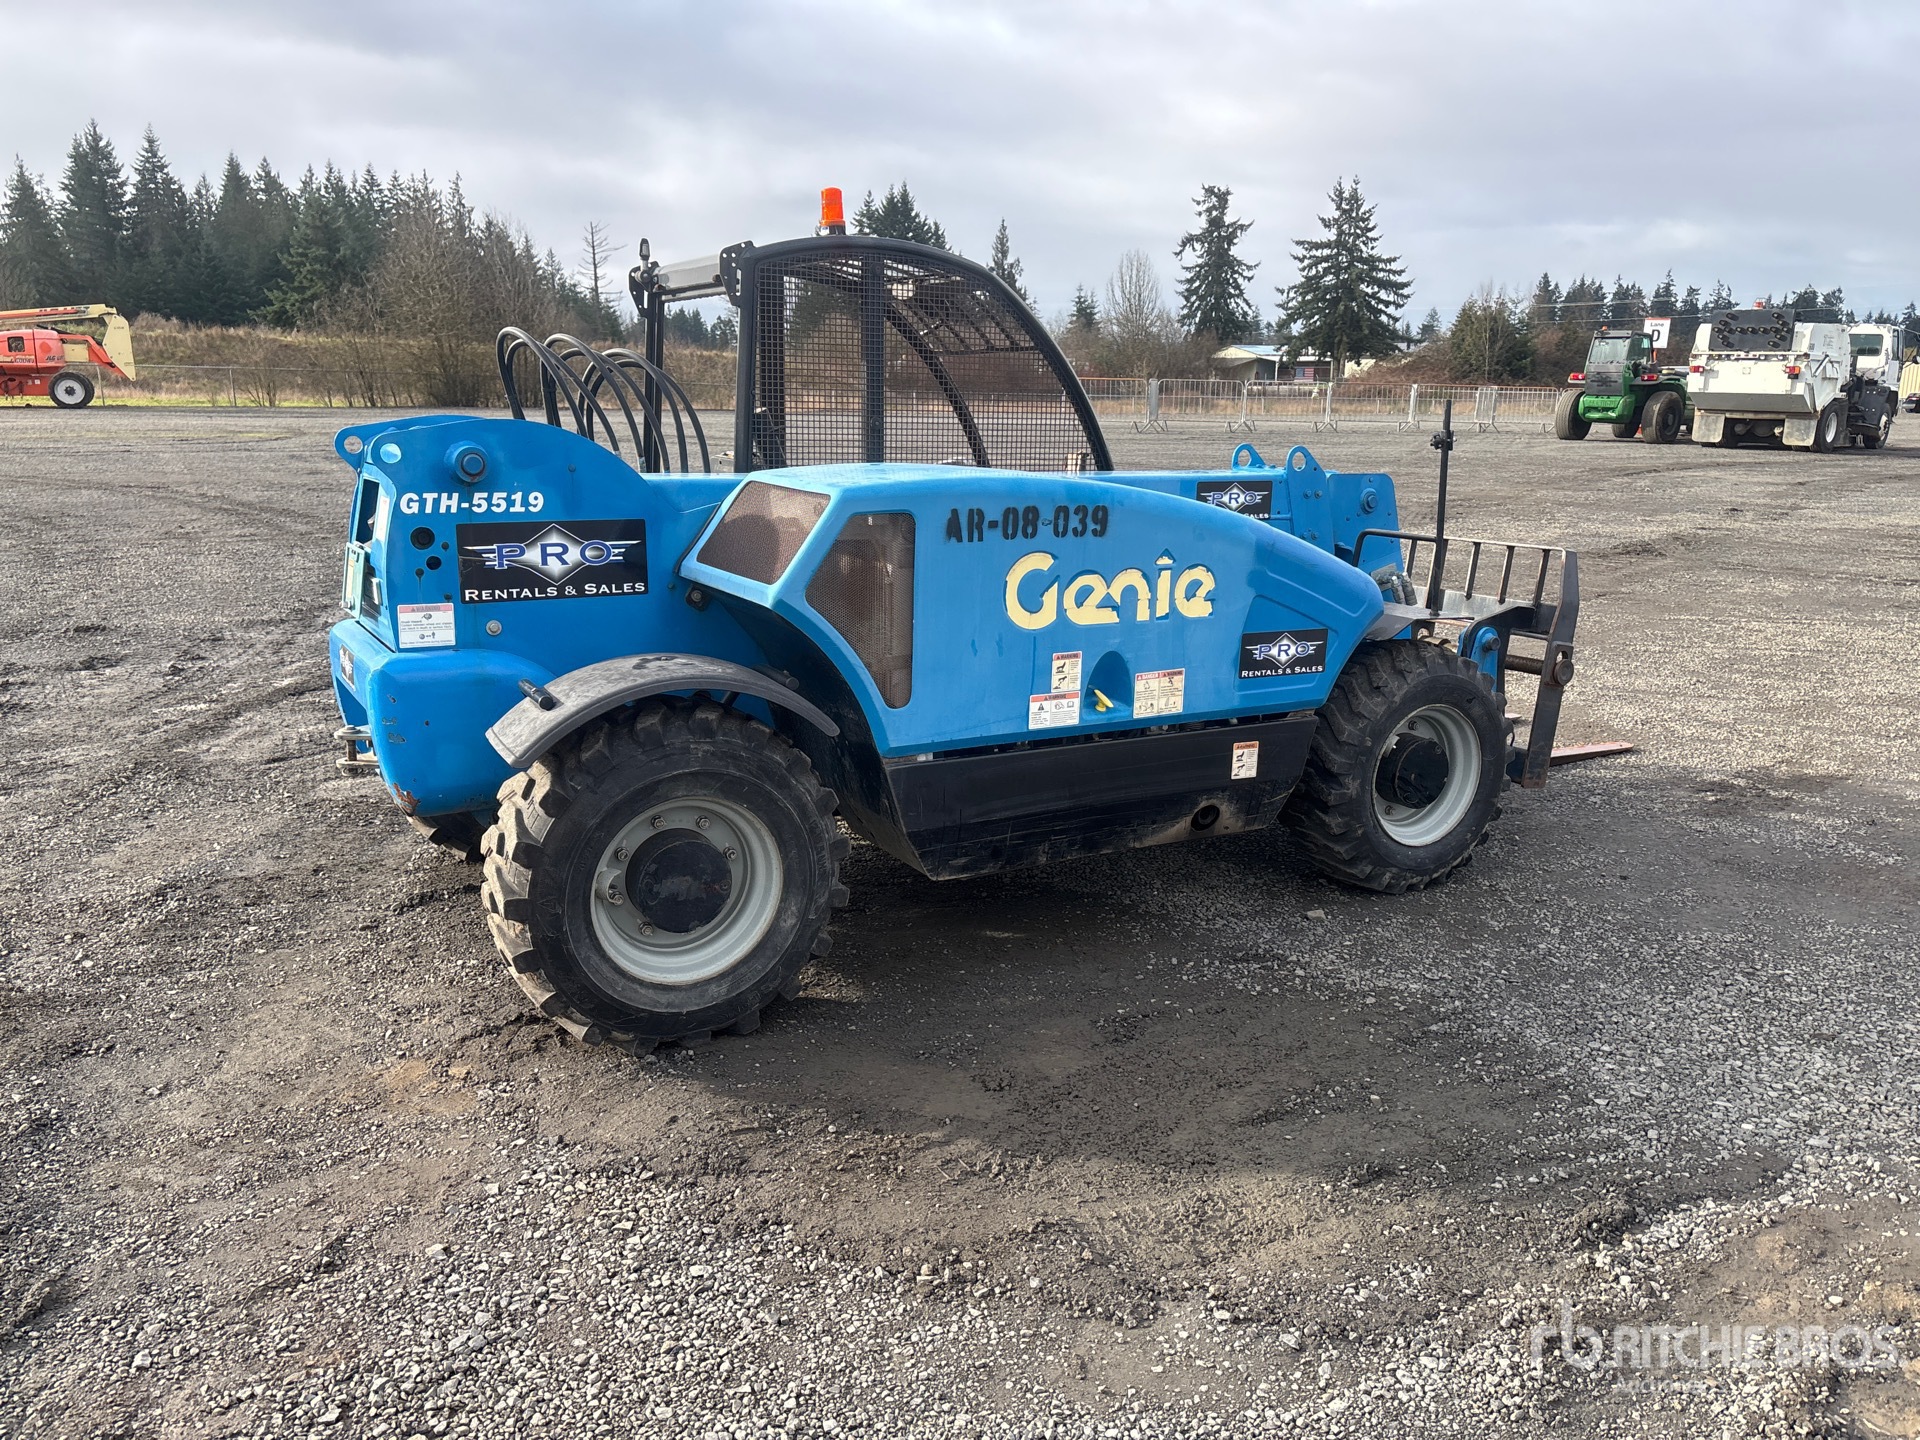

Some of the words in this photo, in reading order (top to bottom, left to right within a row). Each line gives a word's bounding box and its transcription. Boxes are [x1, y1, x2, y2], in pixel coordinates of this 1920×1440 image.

[1652, 329, 1660, 342] D
[400, 491, 544, 514] GTH-5519
[1211, 491, 1257, 506] PRO
[946, 504, 1109, 543] AR-08-039
[494, 539, 613, 570] PRO
[465, 585, 558, 601] RENTALS
[565, 584, 578, 595] &
[584, 582, 645, 594] SALES
[1005, 548, 1215, 630] Genie
[1257, 641, 1311, 660] PRO
[1241, 669, 1283, 678] RENTALS
[1294, 665, 1323, 673] SALES
